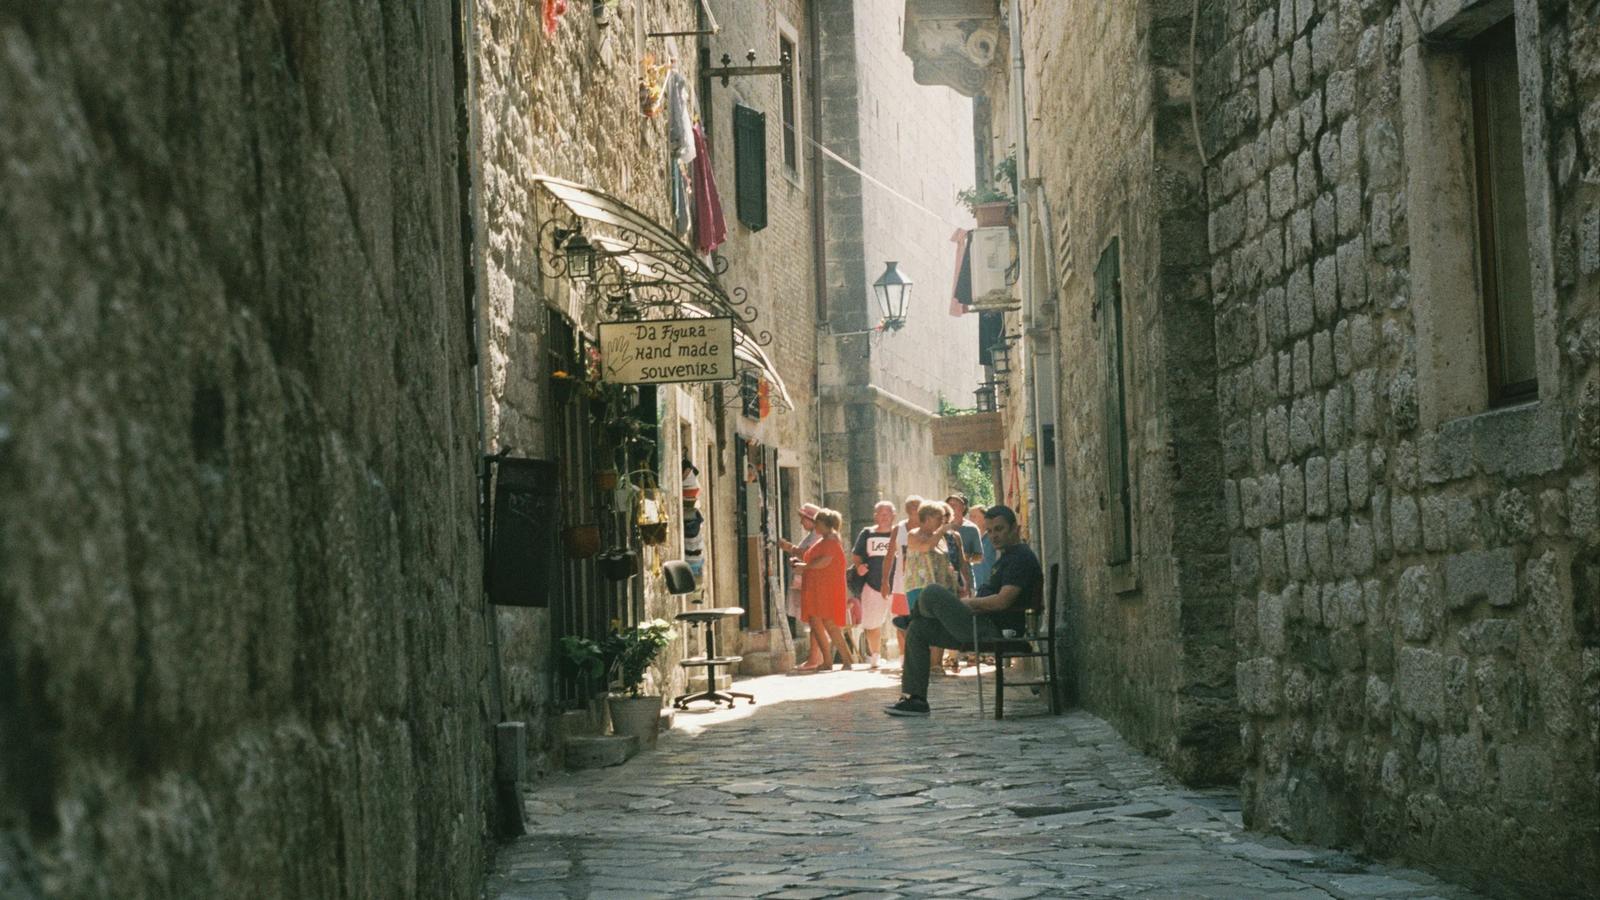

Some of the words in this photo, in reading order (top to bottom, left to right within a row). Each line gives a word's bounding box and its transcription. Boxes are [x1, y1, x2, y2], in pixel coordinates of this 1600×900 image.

[636, 325, 657, 340] Da
[635, 342, 671, 360] Hand
[678, 341, 718, 357] made
